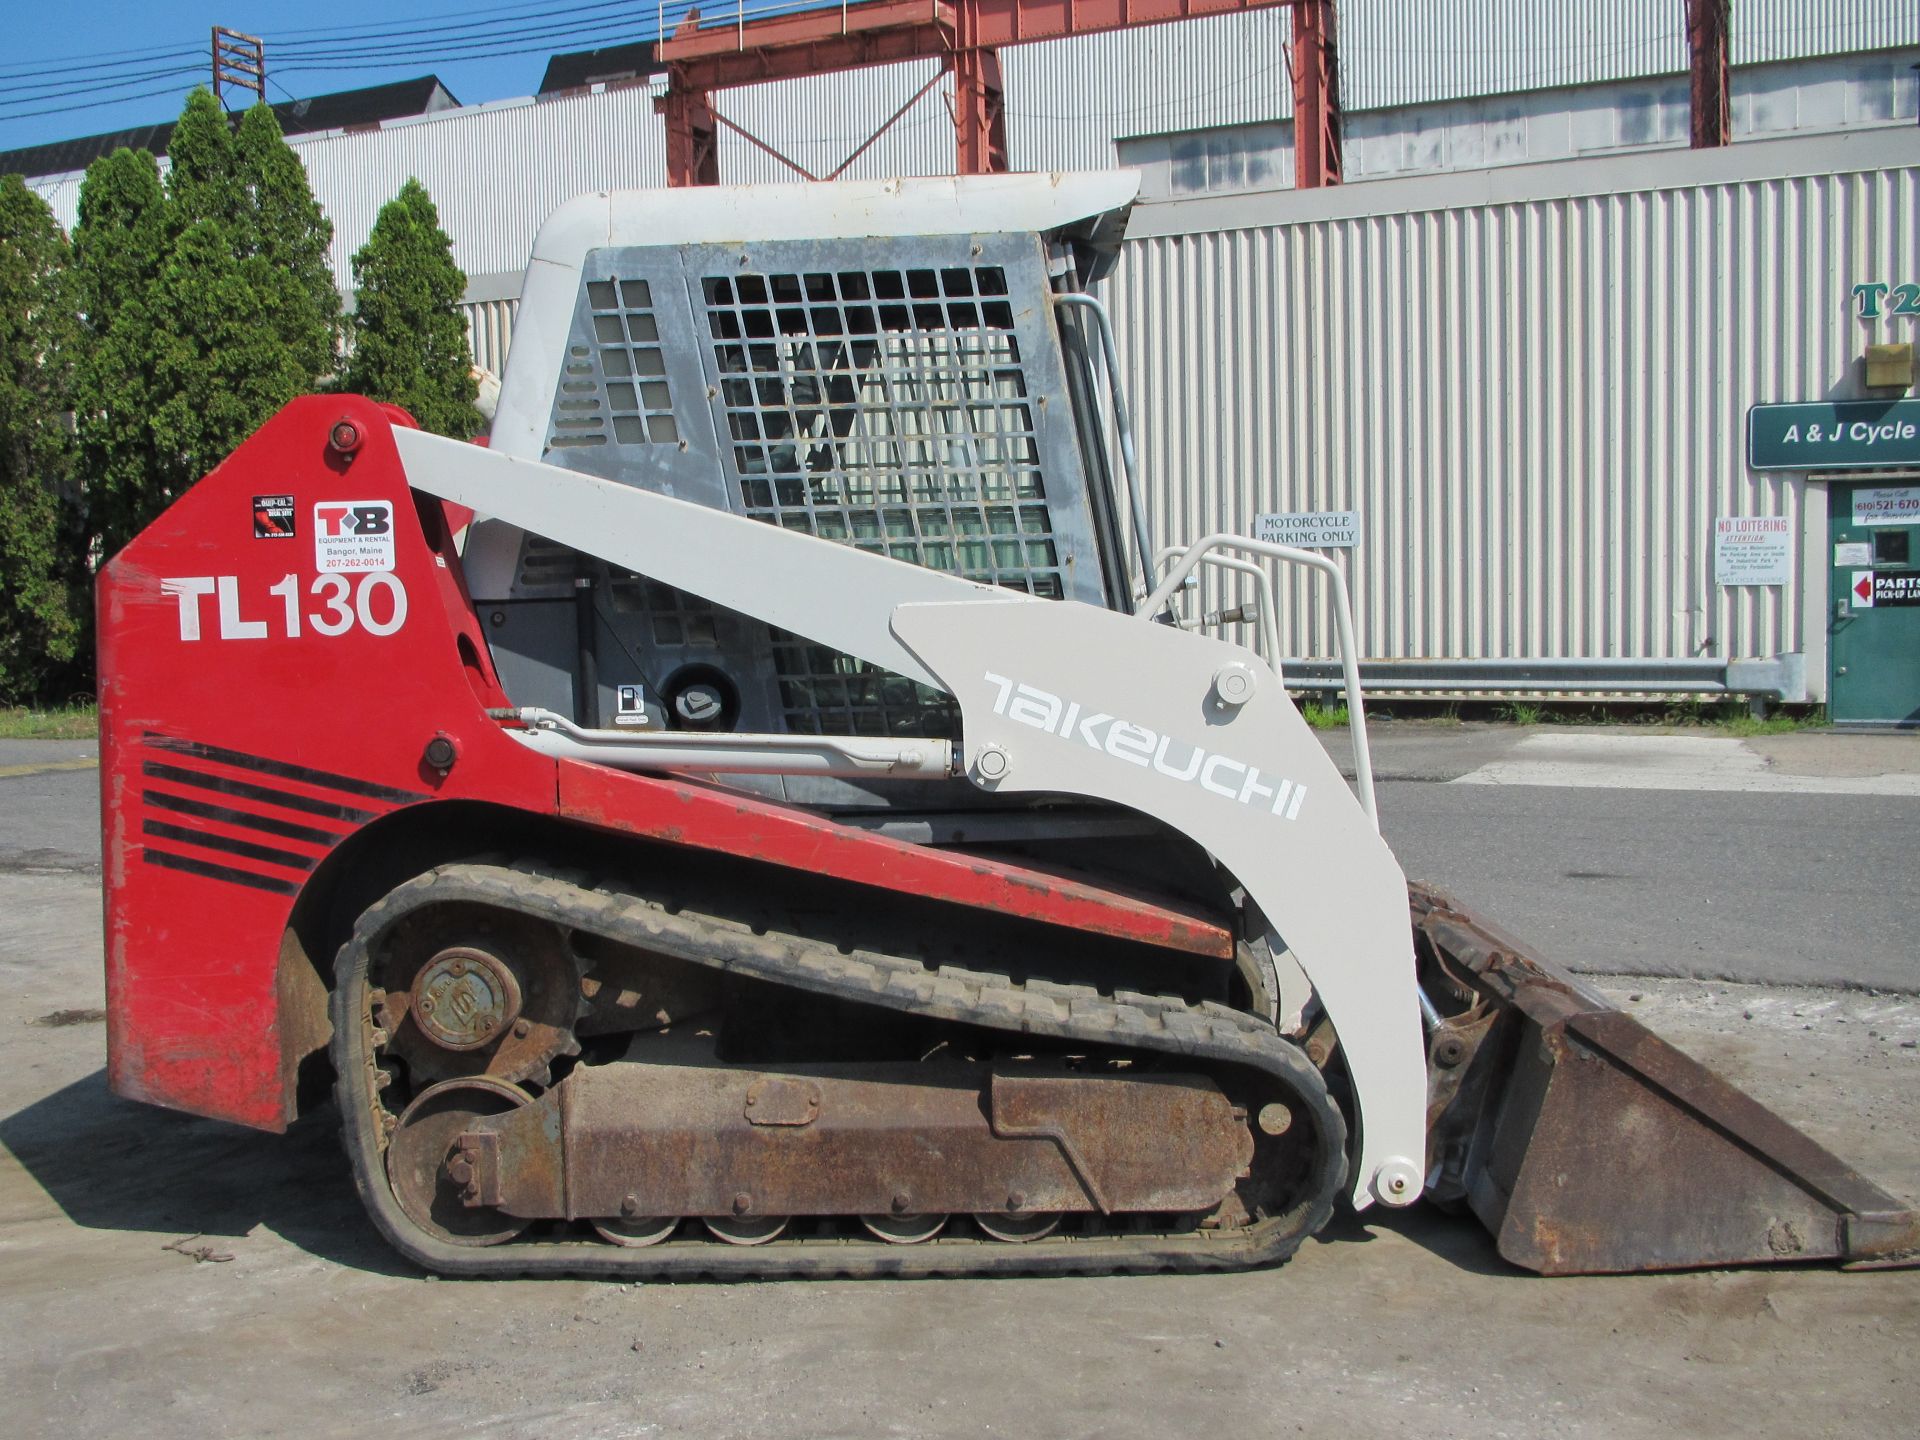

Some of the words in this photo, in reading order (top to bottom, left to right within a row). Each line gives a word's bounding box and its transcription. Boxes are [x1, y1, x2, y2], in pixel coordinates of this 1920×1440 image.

[1783, 424, 1799, 443] A
[1806, 424, 1822, 442] &
[1829, 423, 1843, 441] J
[1850, 421, 1916, 445] Cycle
[1265, 516, 1350, 529] MOTORCYCLE
[1718, 520, 1731, 532] NO
[1736, 520, 1787, 532] LOITERING
[1261, 531, 1317, 543] PARKING
[1322, 531, 1355, 542] ONLY
[327, 548, 358, 556] Bangor,
[326, 558, 385, 567] 207-262-0014
[1876, 589, 1905, 599] PICK-UP
[161, 571, 408, 641] TL130
